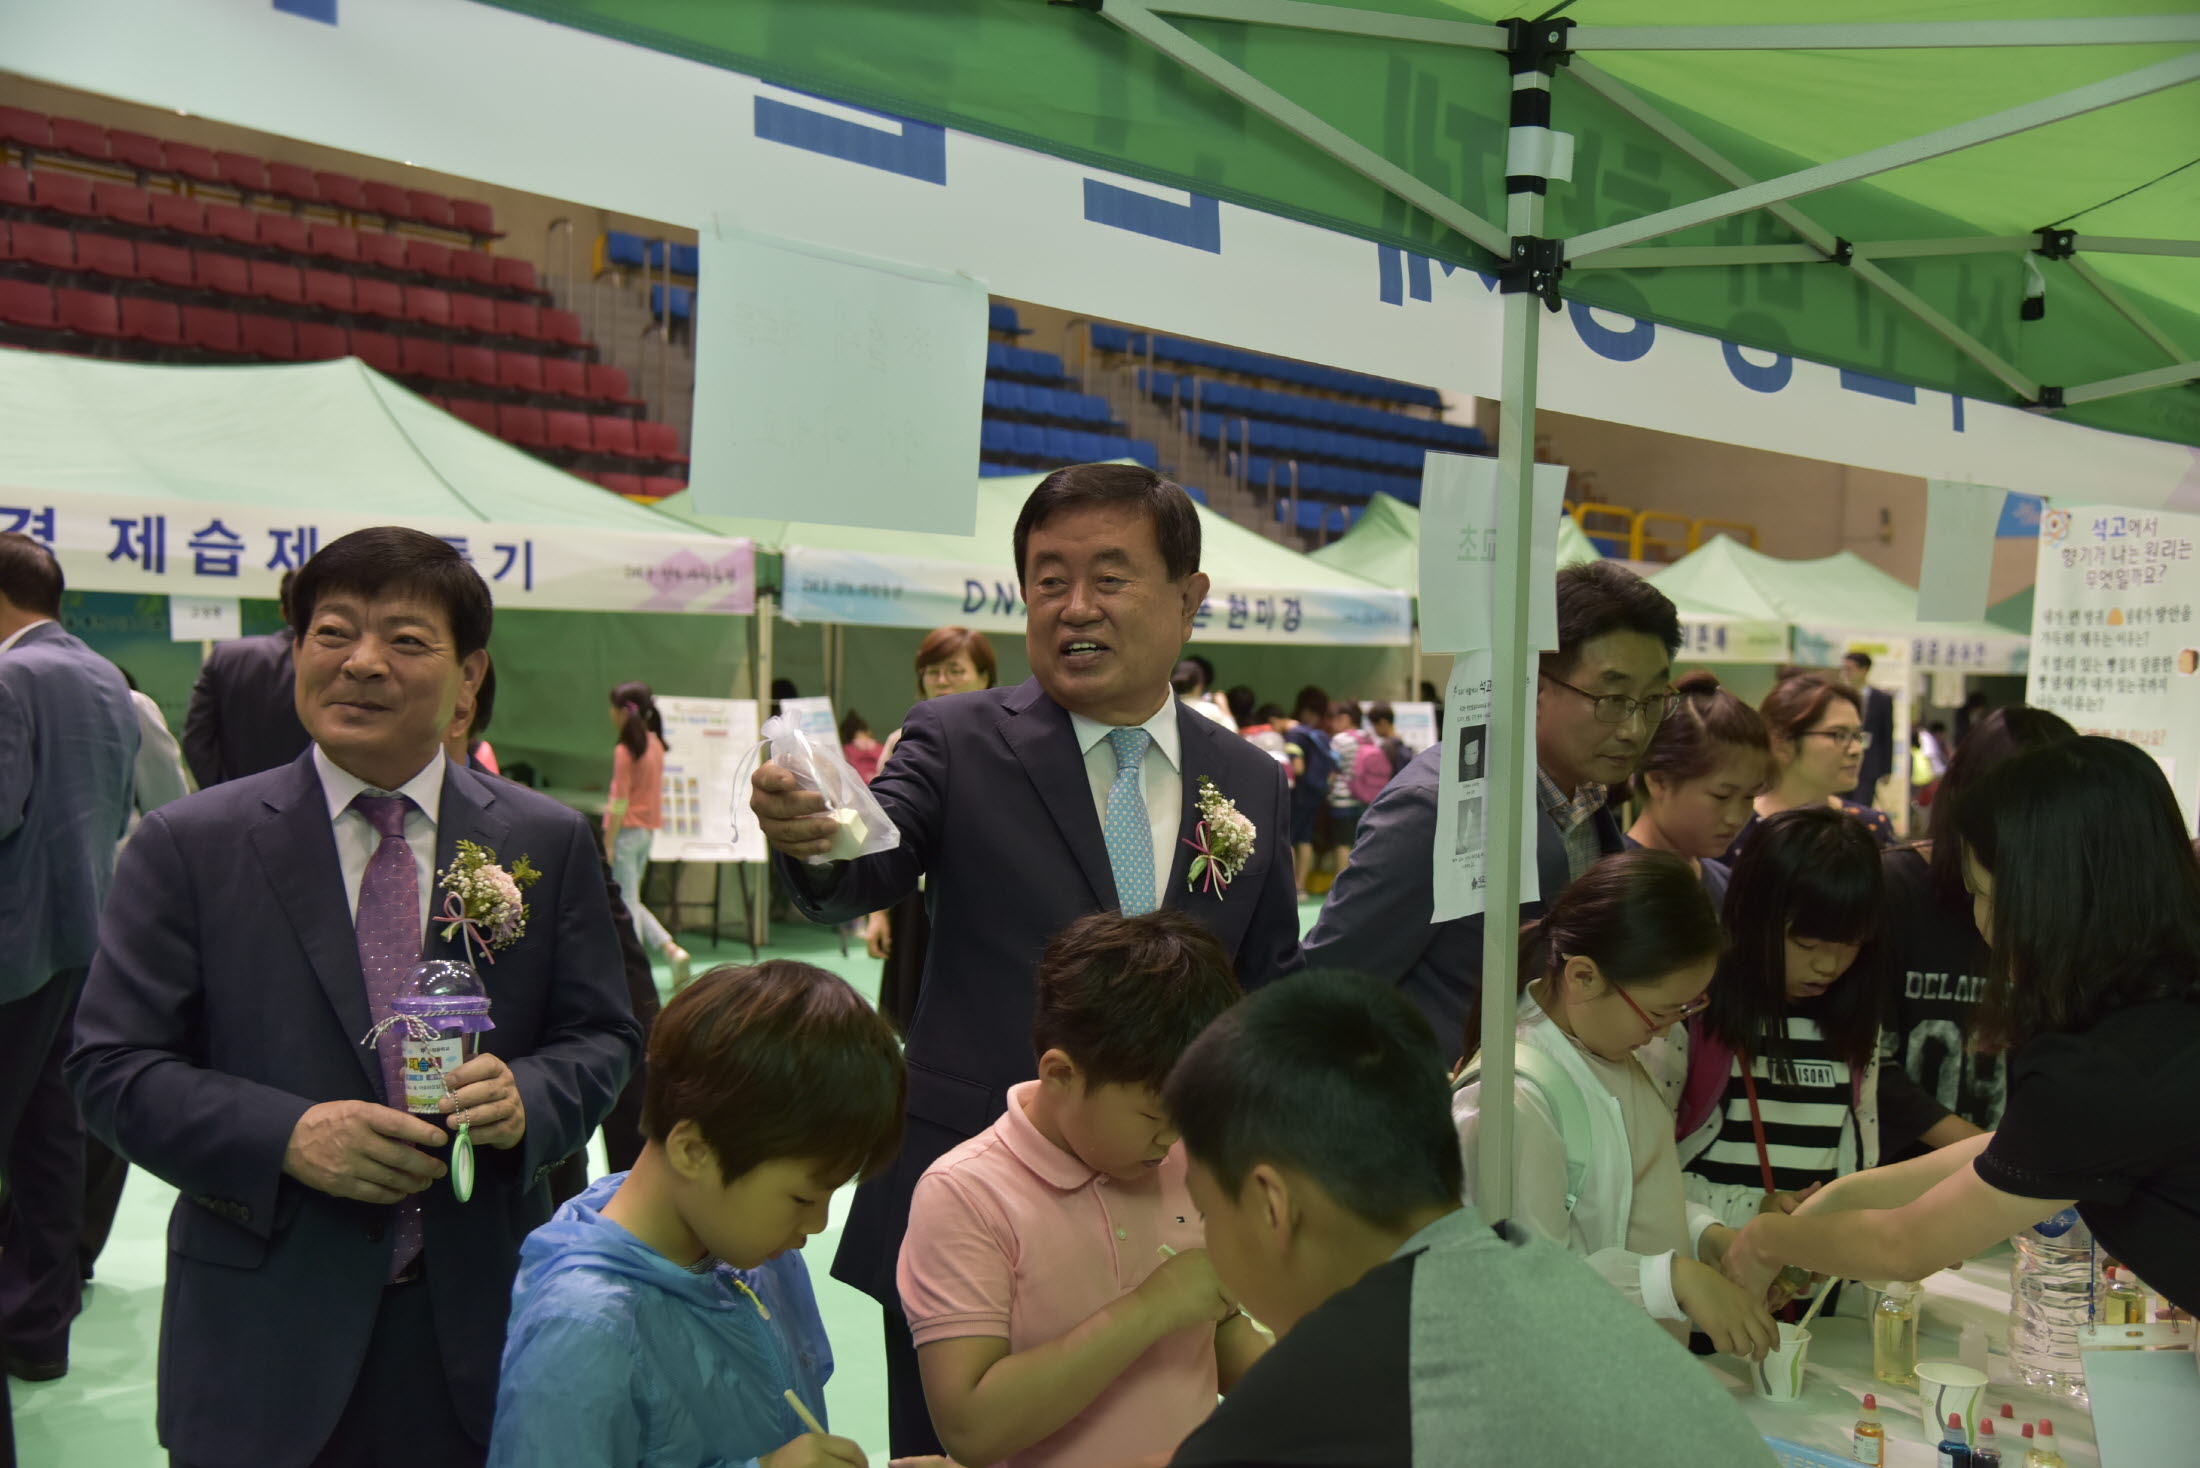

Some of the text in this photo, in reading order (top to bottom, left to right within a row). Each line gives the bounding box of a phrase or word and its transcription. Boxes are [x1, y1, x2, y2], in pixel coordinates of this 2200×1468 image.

[107, 515, 317, 577] 제습제
[2092, 516, 2159, 541] 석고에서
[2144, 538, 2193, 564] 원리는
[963, 580, 1027, 616] DN
[1227, 592, 1302, 632] 현미경
